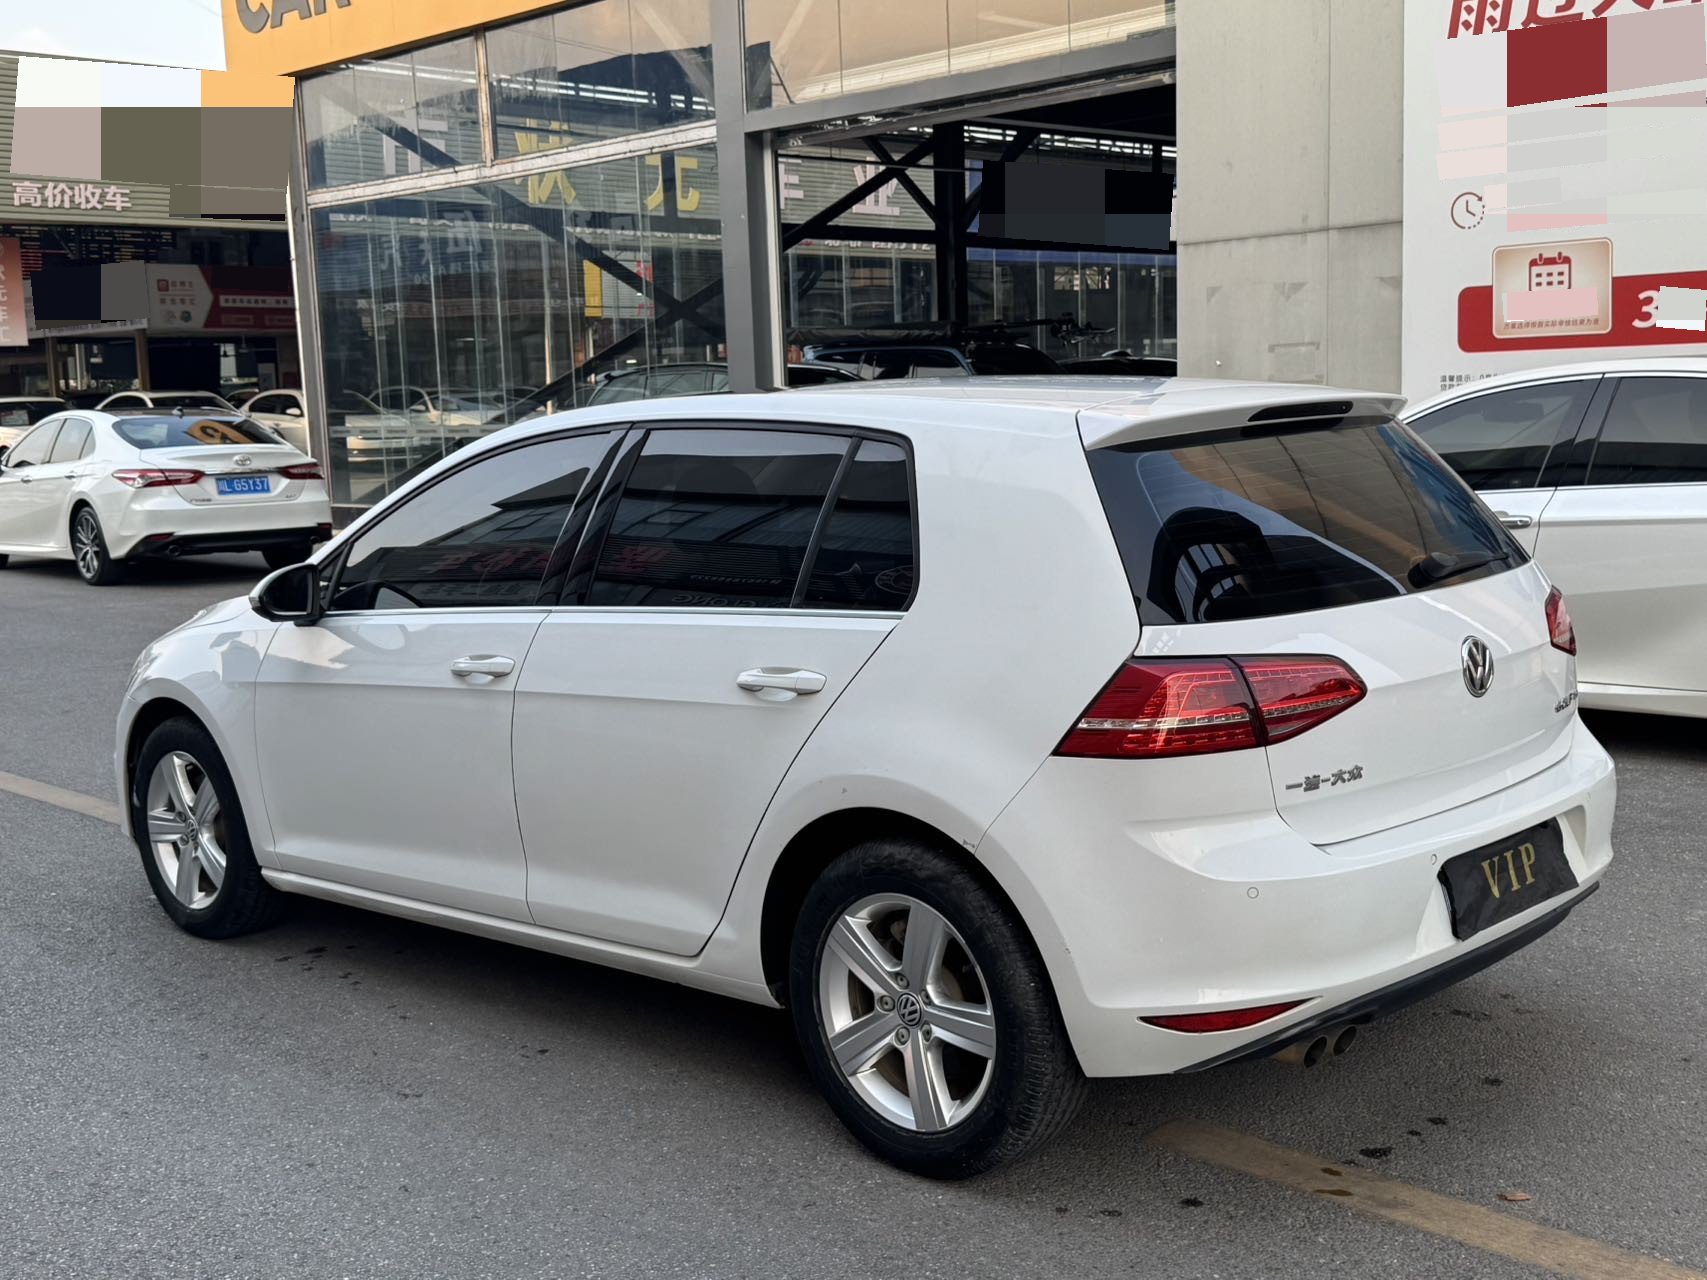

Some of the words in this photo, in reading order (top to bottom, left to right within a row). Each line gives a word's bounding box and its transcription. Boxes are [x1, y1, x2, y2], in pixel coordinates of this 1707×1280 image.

[12, 181, 132, 211] 高价收车
[1481, 843, 1536, 899] VIP
